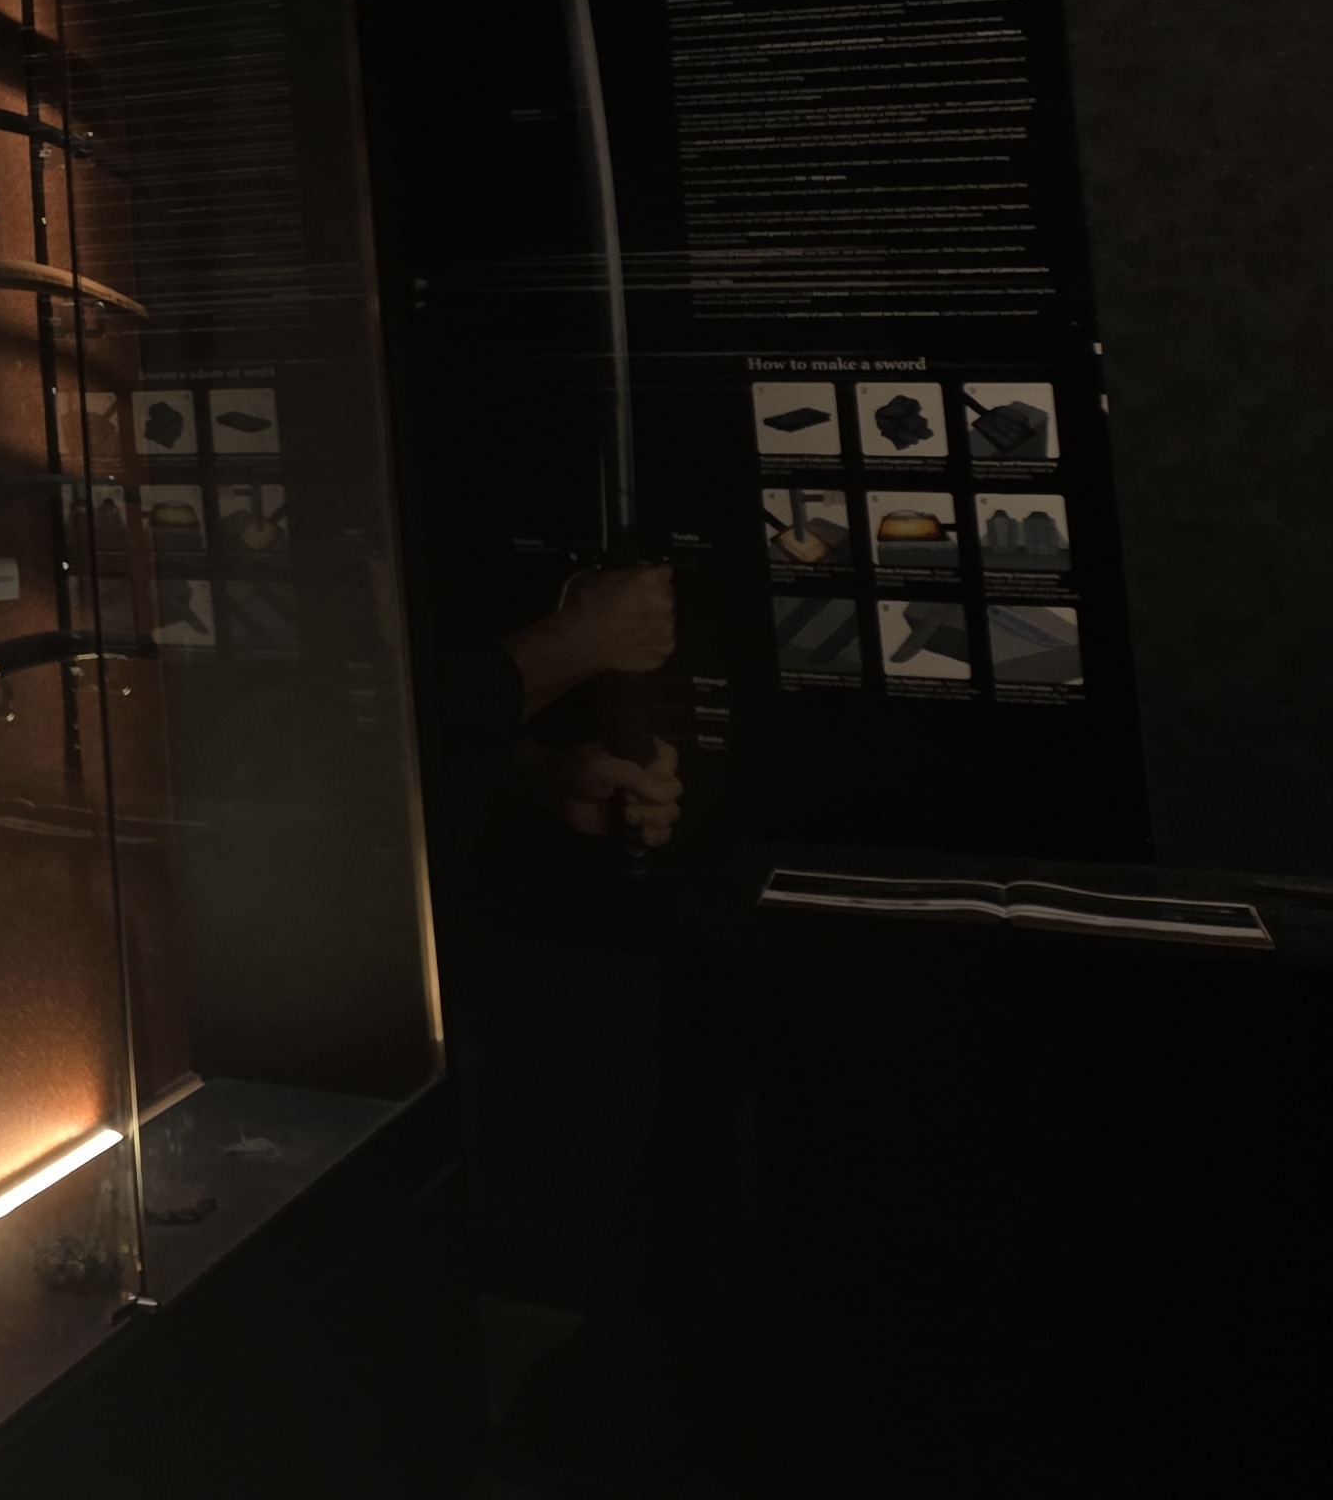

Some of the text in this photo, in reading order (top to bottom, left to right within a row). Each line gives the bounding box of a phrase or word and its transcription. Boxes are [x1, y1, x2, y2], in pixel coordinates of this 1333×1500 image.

[748, 356, 927, 371] How to make a sword
